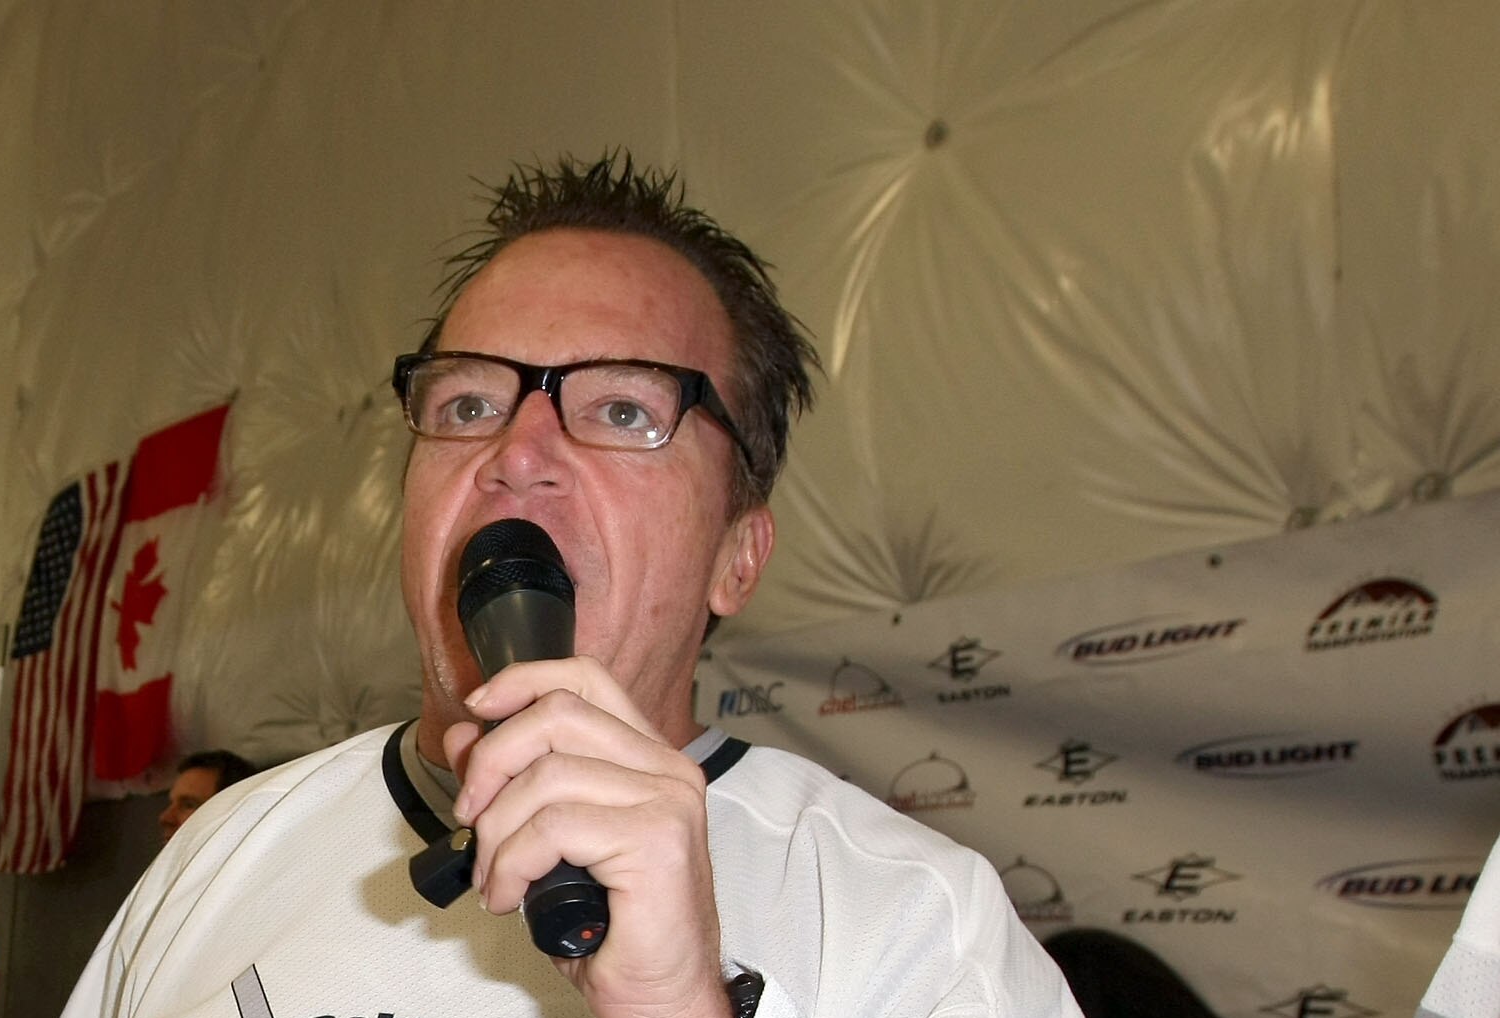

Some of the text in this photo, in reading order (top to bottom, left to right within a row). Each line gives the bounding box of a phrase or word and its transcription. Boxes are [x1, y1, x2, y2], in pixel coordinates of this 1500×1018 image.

[1072, 617, 1246, 661] BUD LIGHT
[1195, 740, 1359, 770] BUD LIGHT
[1023, 790, 1128, 807] EASTON
[1338, 876, 1423, 897] BUD
[1122, 908, 1238, 924] EASTON
